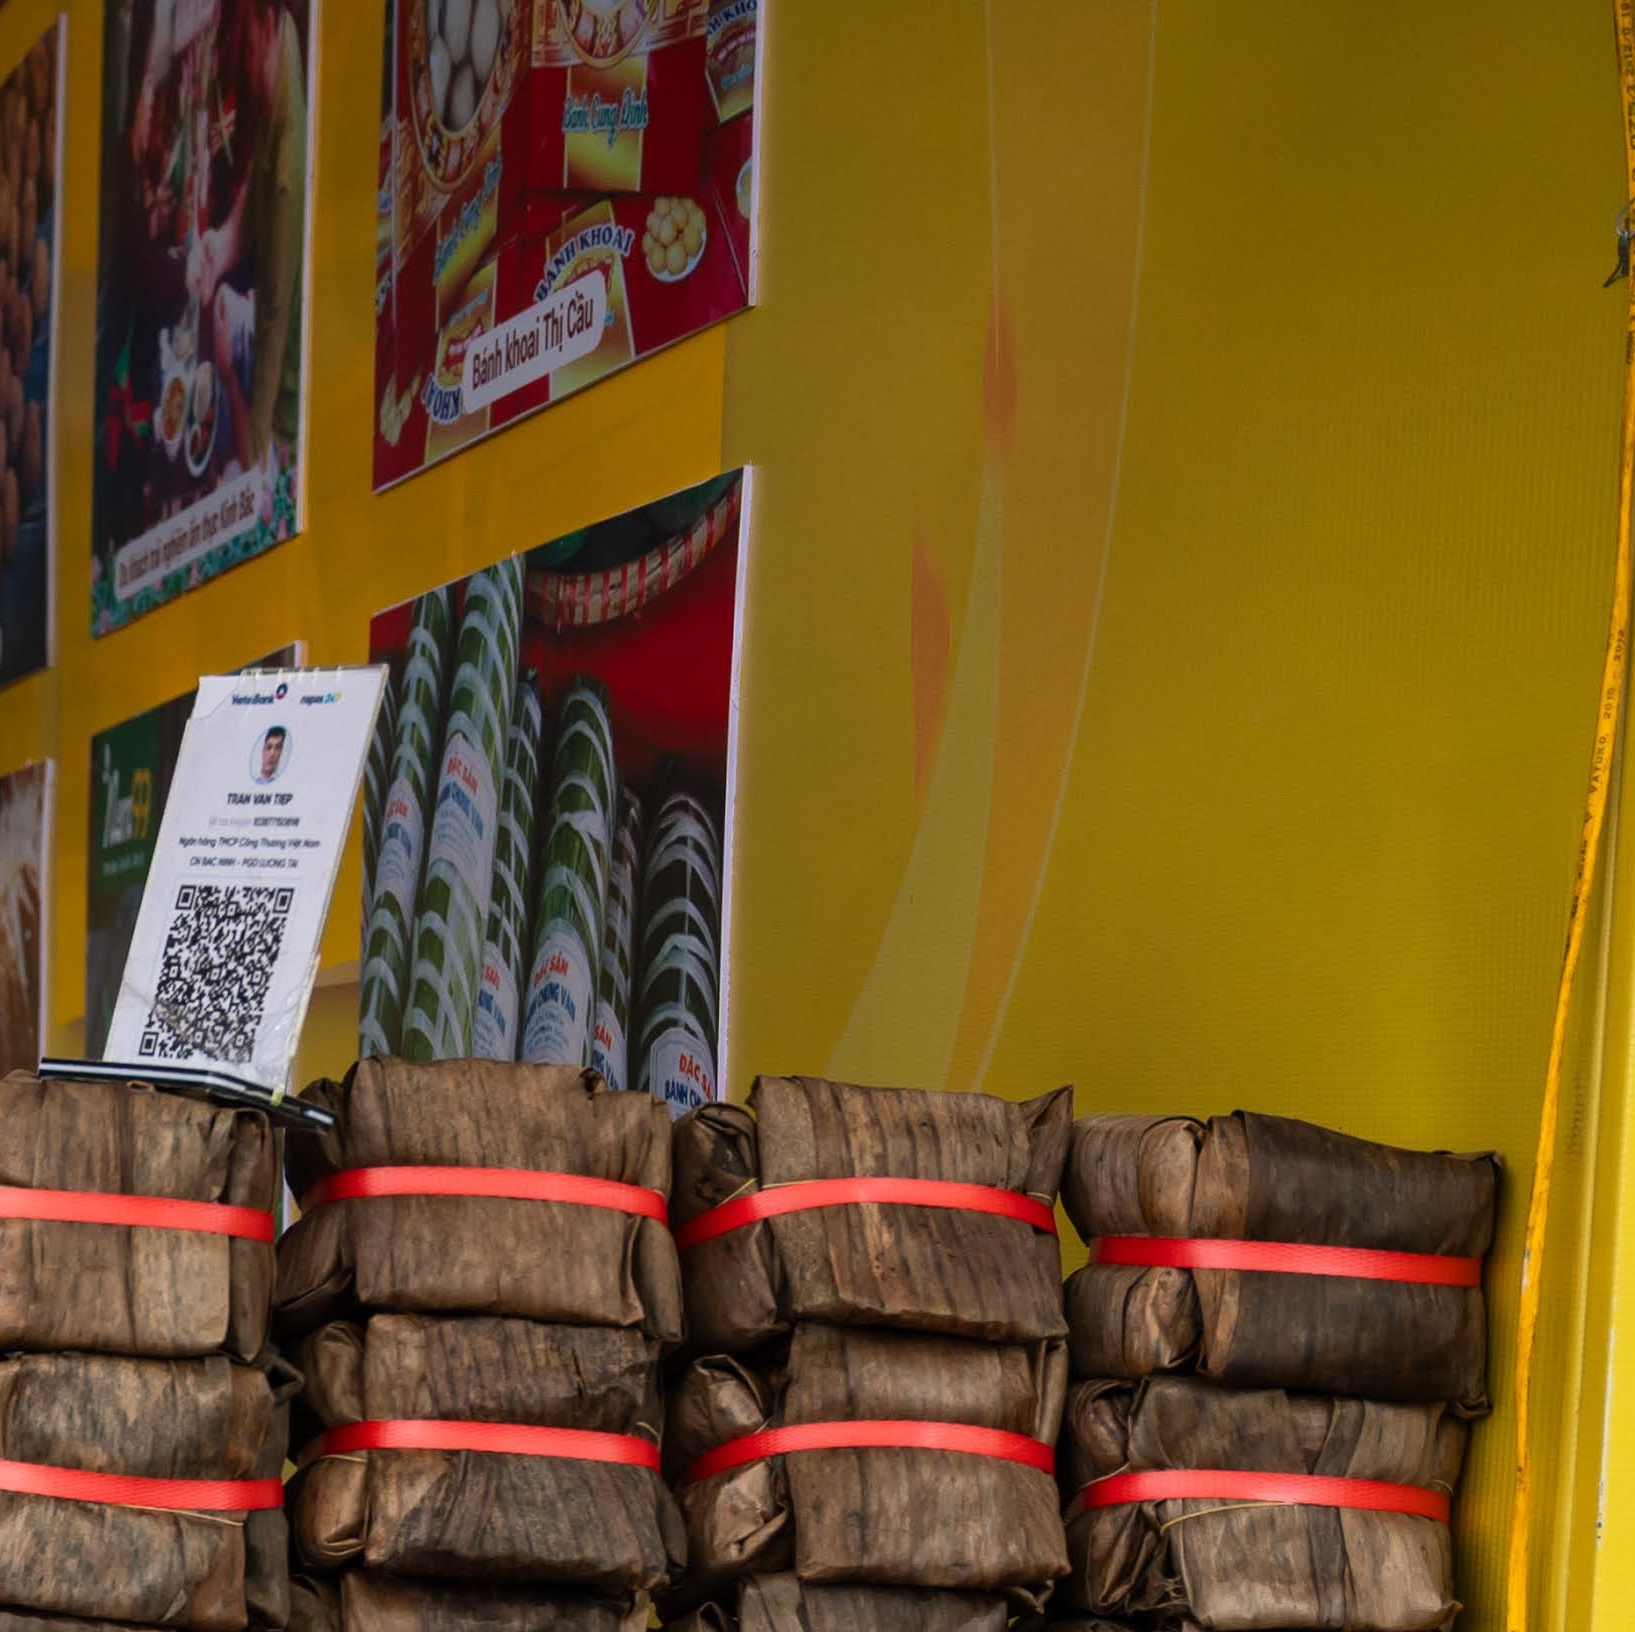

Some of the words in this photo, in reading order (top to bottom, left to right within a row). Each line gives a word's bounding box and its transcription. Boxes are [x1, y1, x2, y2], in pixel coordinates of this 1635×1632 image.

[578, 226, 633, 254] KHOAI
[472, 338, 503, 390] Bánh
[505, 315, 540, 373] khoai
[543, 303, 565, 353] Thị
[567, 290, 594, 340] Cầu
